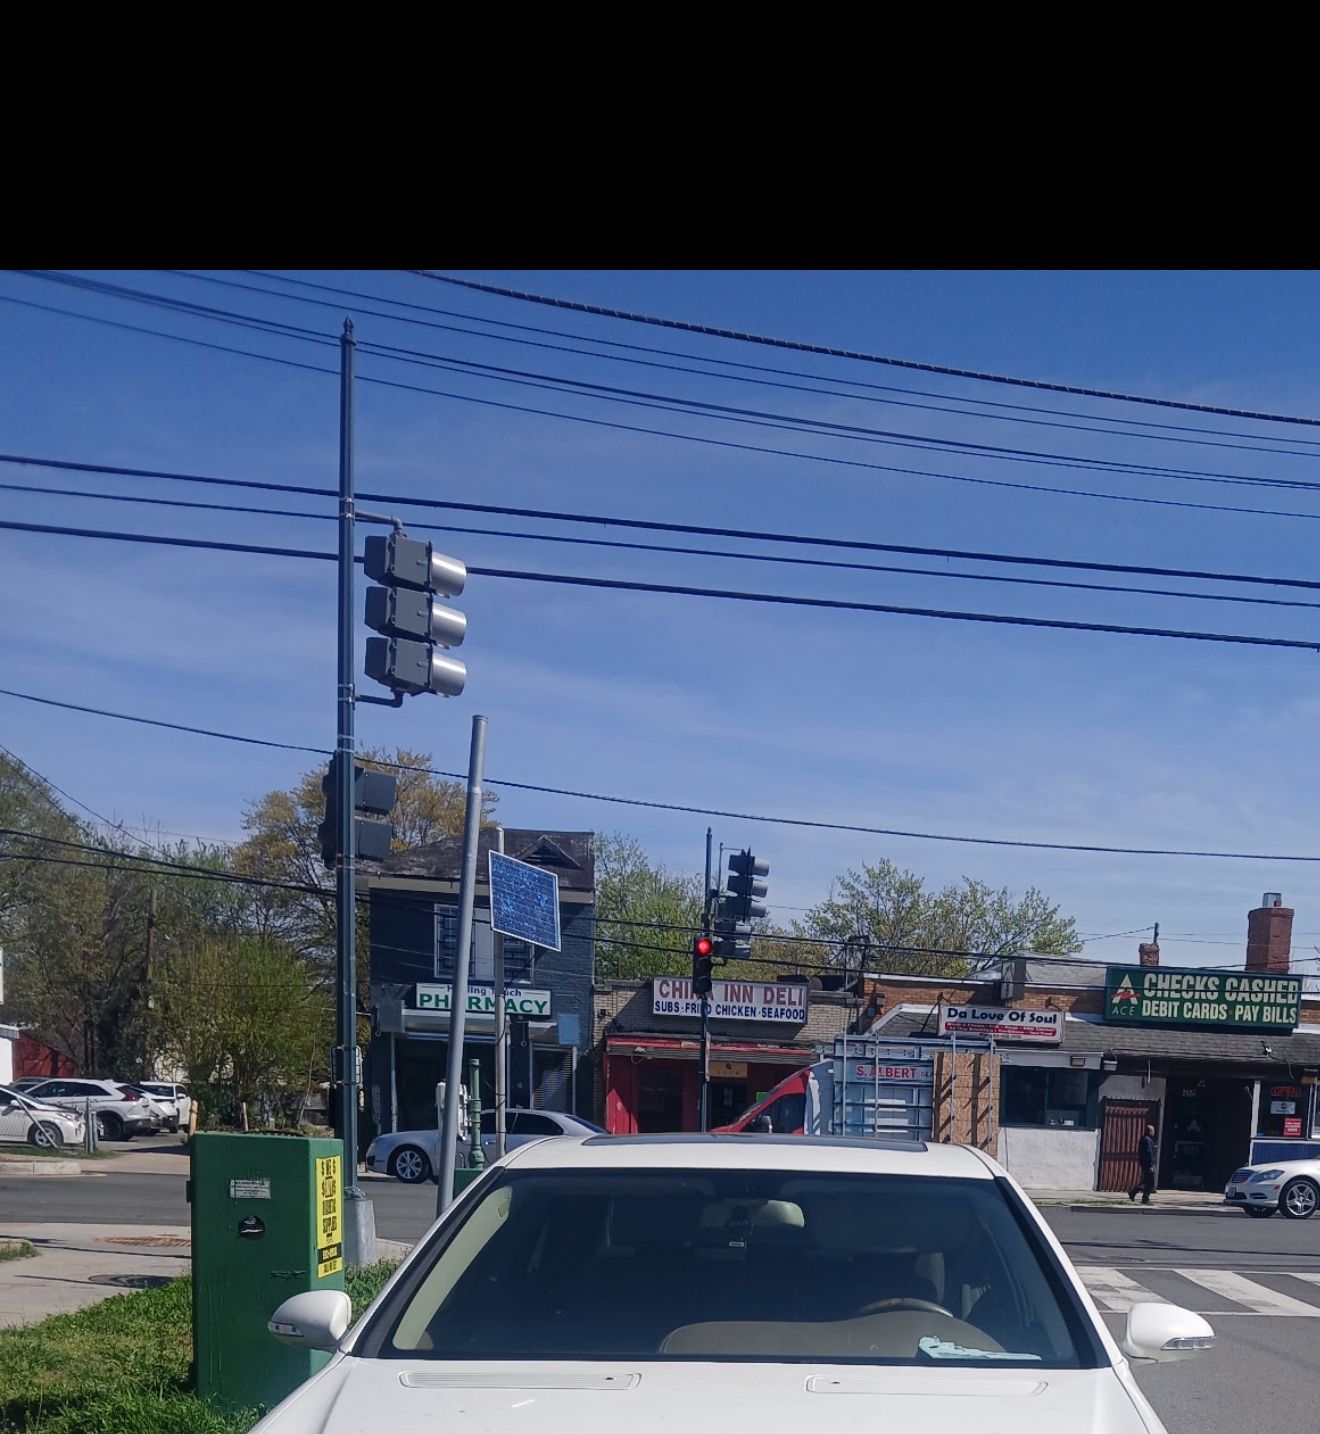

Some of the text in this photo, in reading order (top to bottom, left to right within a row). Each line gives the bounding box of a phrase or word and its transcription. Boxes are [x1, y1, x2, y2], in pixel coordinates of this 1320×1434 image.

[724, 983, 753, 1004] INN
[763, 986, 803, 1007] DELI
[1143, 973, 1299, 1004] CHECKS CASHED
[419, 993, 548, 1014] PHRMACY
[1111, 1005, 1136, 1016] ACE
[1141, 999, 1297, 1024] DEBIT CARDS PAY BILLS
[947, 1007, 1057, 1024] Da Love Of Soul
